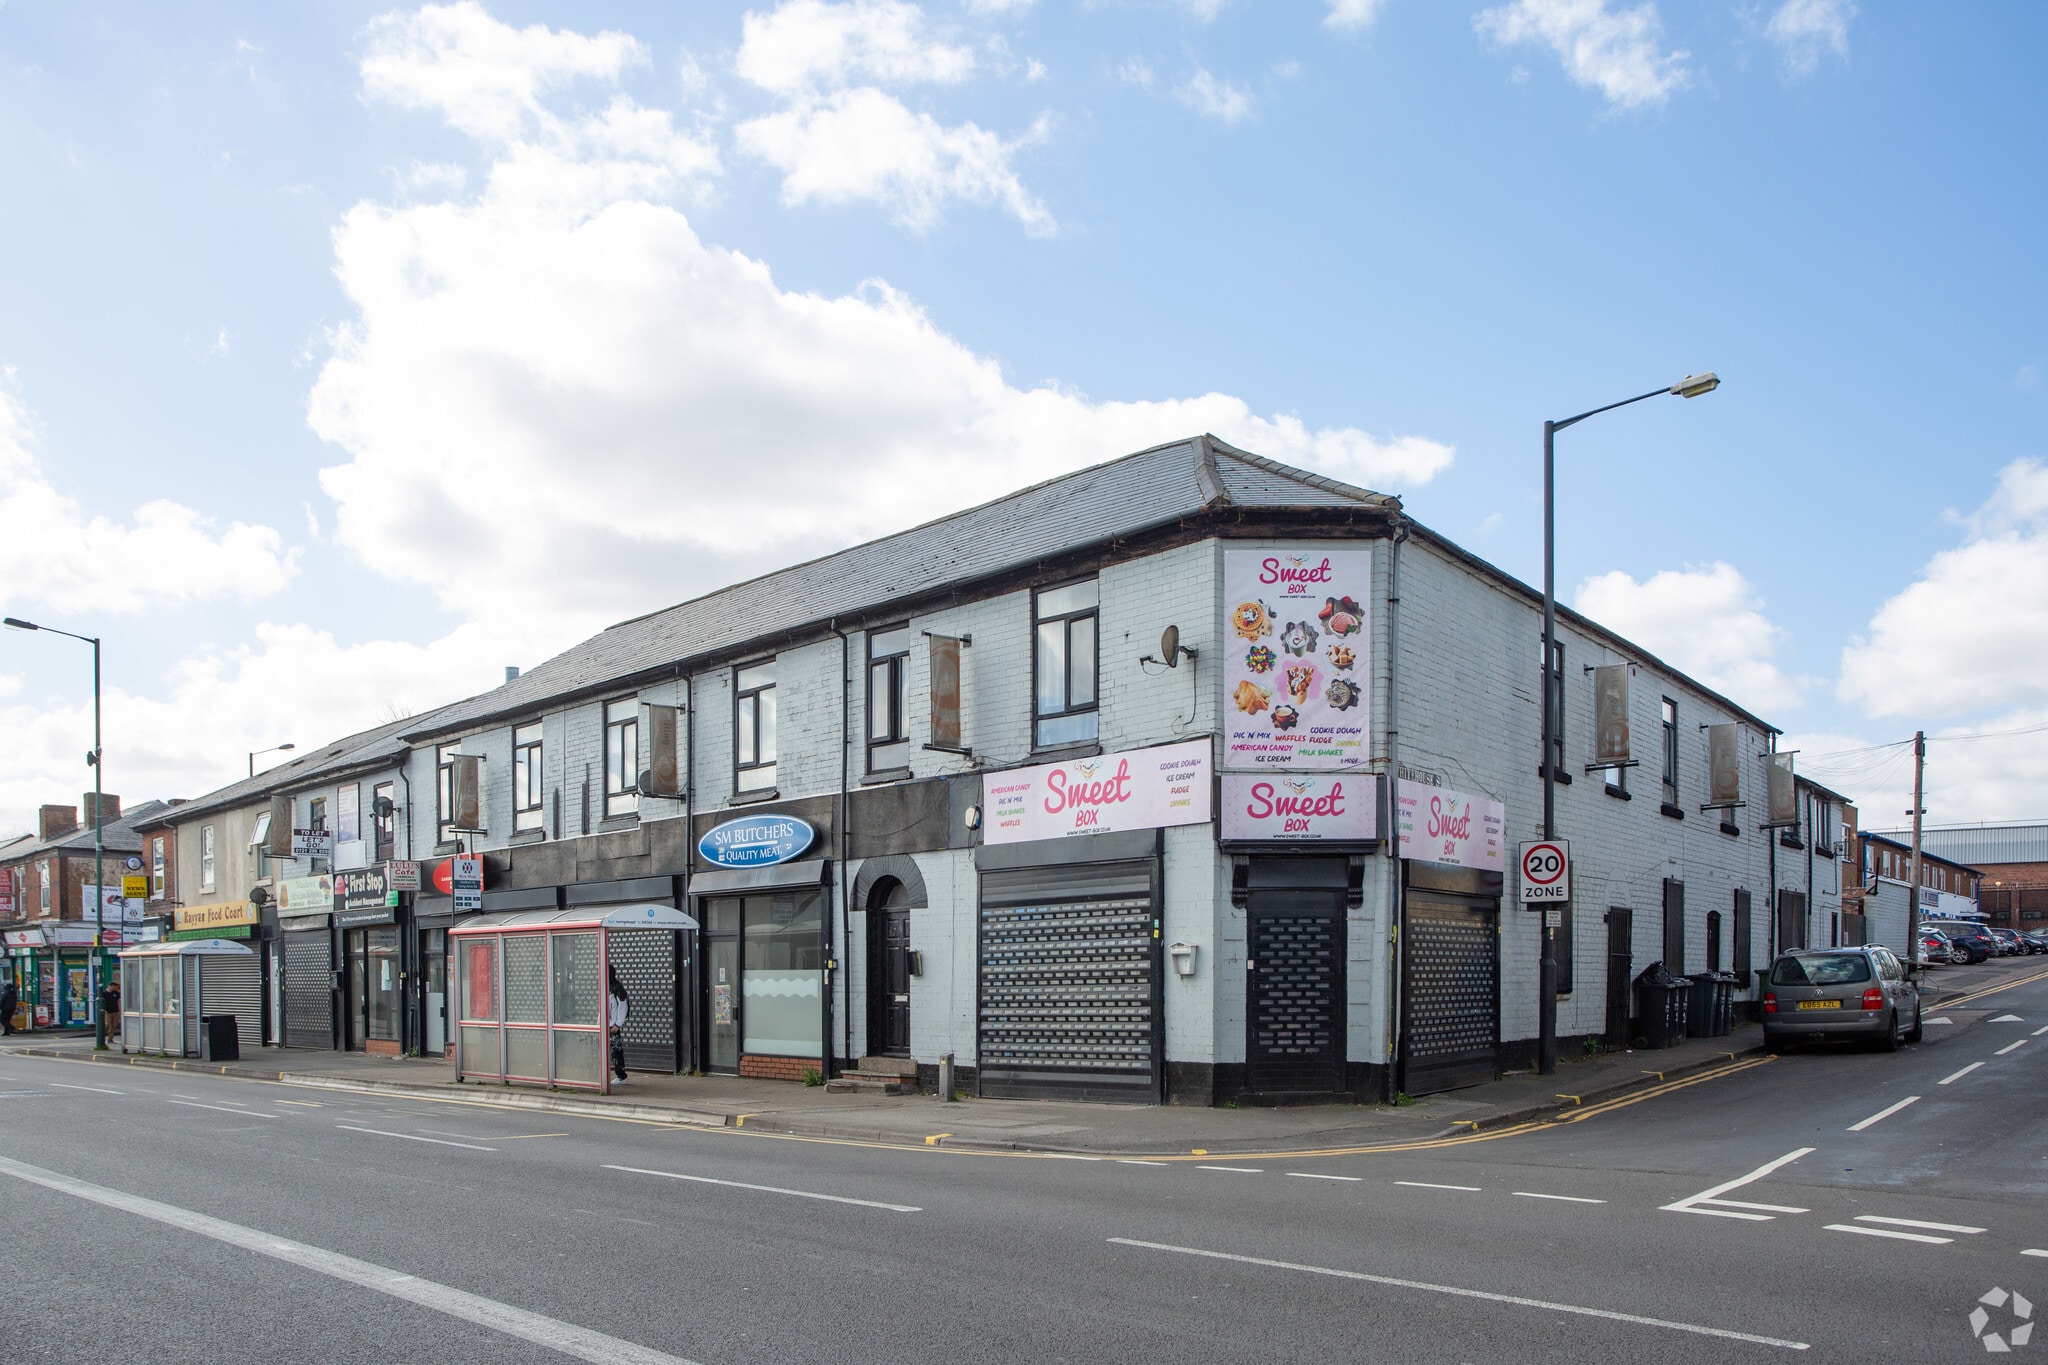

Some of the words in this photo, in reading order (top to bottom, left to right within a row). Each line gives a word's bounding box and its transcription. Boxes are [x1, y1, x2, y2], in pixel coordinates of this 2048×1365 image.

[1259, 557, 1332, 584] Sweet
[1287, 584, 1307, 594] BOX
[1160, 761, 1180, 771] COOKIE
[1180, 758, 1201, 767] DOUGH
[1166, 774, 1174, 782] ICE
[1175, 772, 1195, 781] CREAM
[991, 785, 1015, 795] AMERICAN
[1015, 783, 1031, 792] CANDY
[1044, 758, 1132, 814] Sweet
[1170, 785, 1190, 794] FUDGE
[1013, 796, 1023, 804] MIX
[1247, 782, 1345, 819] Sweet
[1000, 819, 1021, 828] WAFFLES
[1075, 808, 1099, 828] BOX
[1428, 795, 1470, 840] Sweet
[1284, 818, 1311, 832] BOX
[715, 830, 731, 845] SM
[734, 822, 794, 843] BUTCHERS
[1444, 840, 1455, 855] BOX
[726, 850, 758, 863] QUALITY
[390, 861, 420, 869] LULU'S
[1530, 856, 1559, 872] 20
[350, 874, 365, 893] First
[366, 872, 383, 894] Stop
[1525, 886, 1563, 897] ZONE
[184, 911, 206, 926] Rayyan
[208, 907, 222, 923] Food
[224, 905, 243, 919] Court
